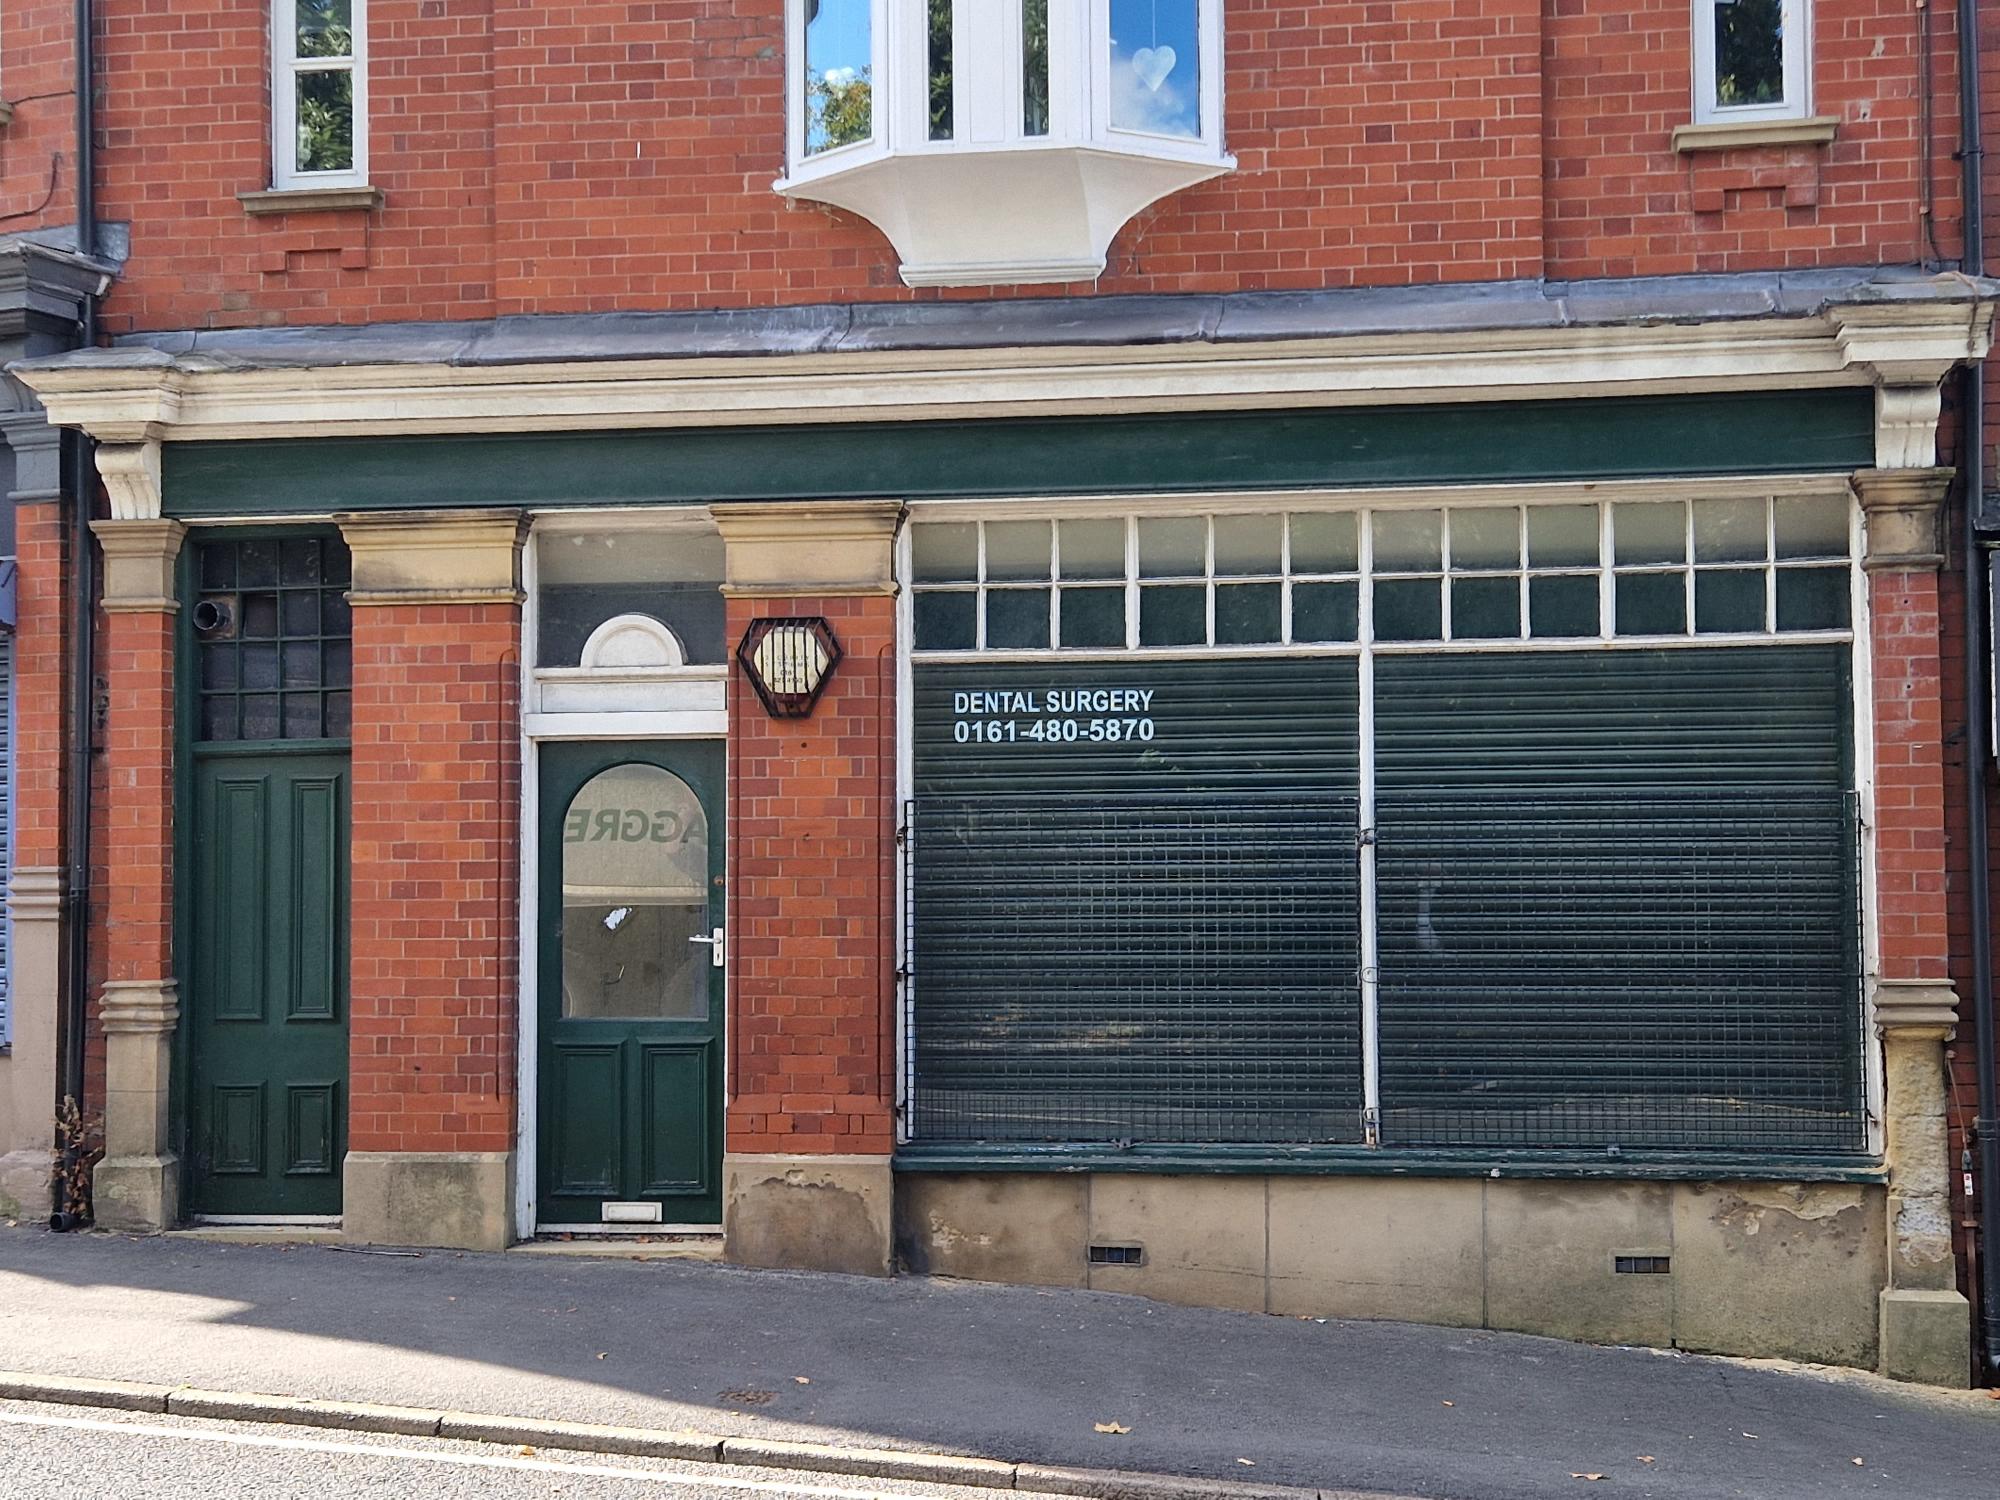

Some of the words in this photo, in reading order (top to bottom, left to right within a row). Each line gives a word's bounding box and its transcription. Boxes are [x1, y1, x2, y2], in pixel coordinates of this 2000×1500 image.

[954, 691, 1041, 714] DENTAL
[1046, 689, 1154, 713] SURGERY
[954, 718, 1155, 743] 0161-480-5870
